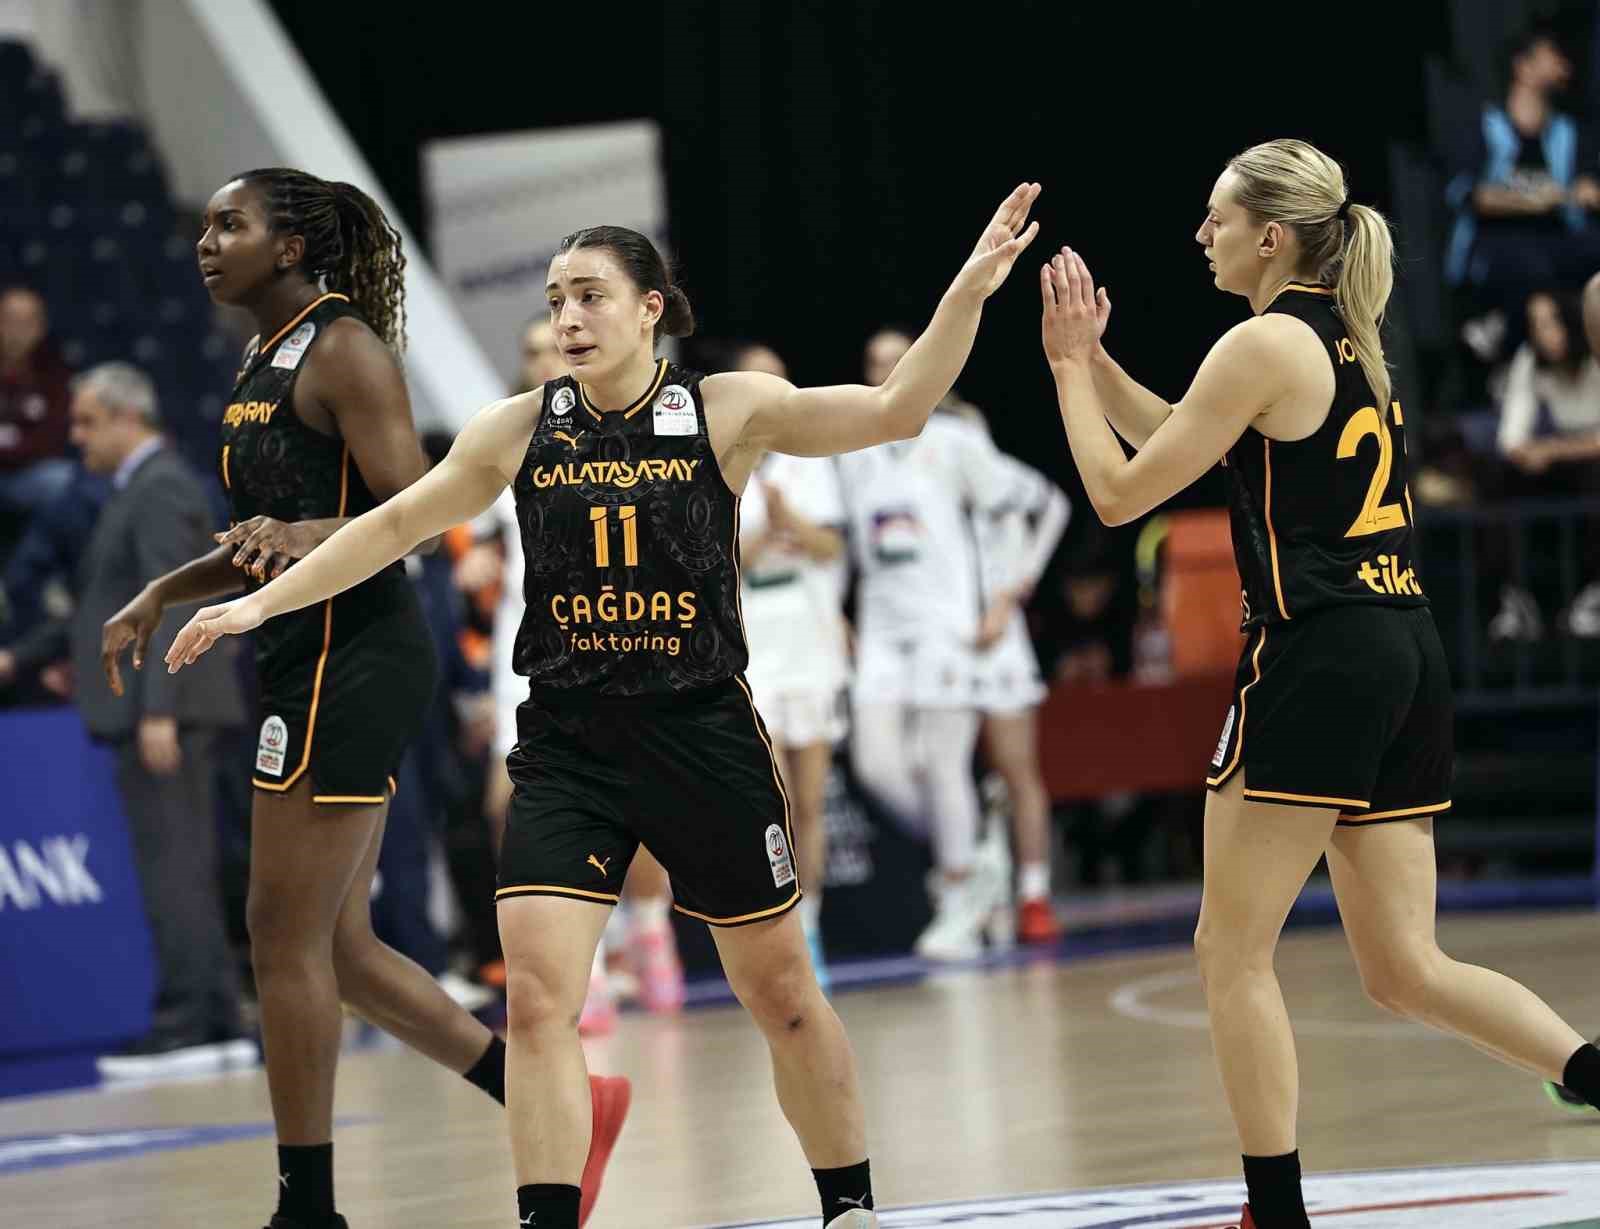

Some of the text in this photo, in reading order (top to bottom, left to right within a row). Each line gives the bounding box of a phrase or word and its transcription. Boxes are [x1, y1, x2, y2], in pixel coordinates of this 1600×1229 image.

[532, 458, 700, 489] GALATASARAY
[589, 505, 639, 568] 11
[551, 584, 697, 630] ÇAĞDAŞ
[570, 630, 681, 656] faktoring
